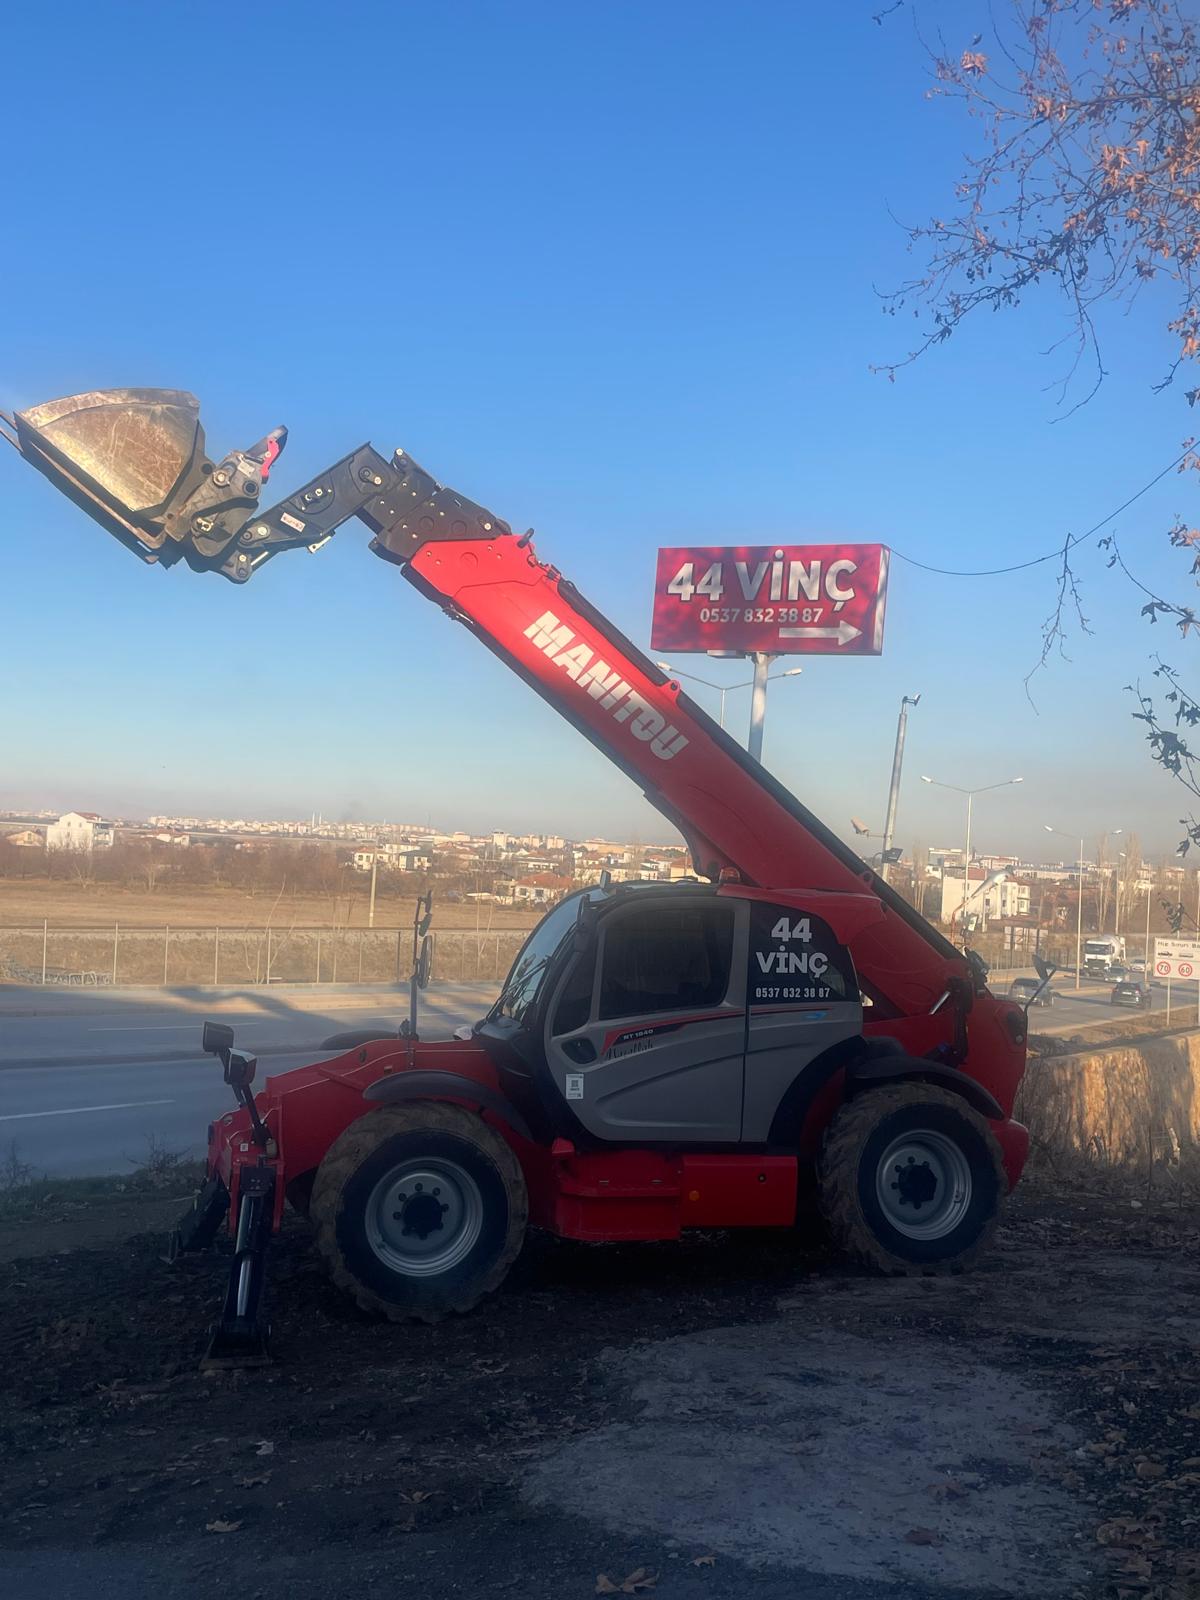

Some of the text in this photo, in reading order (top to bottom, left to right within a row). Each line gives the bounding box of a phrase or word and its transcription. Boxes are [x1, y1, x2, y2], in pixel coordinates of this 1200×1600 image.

[667, 549, 858, 611] 44 VİNÇ
[700, 607, 824, 623] 0537 832 38 87
[523, 610, 690, 761] MANITOU
[771, 917, 812, 943] 44
[755, 945, 828, 978] VİNÇ
[1160, 964, 1168, 972] 70
[755, 987, 780, 998] 0537
[803, 987, 816, 998] 38
